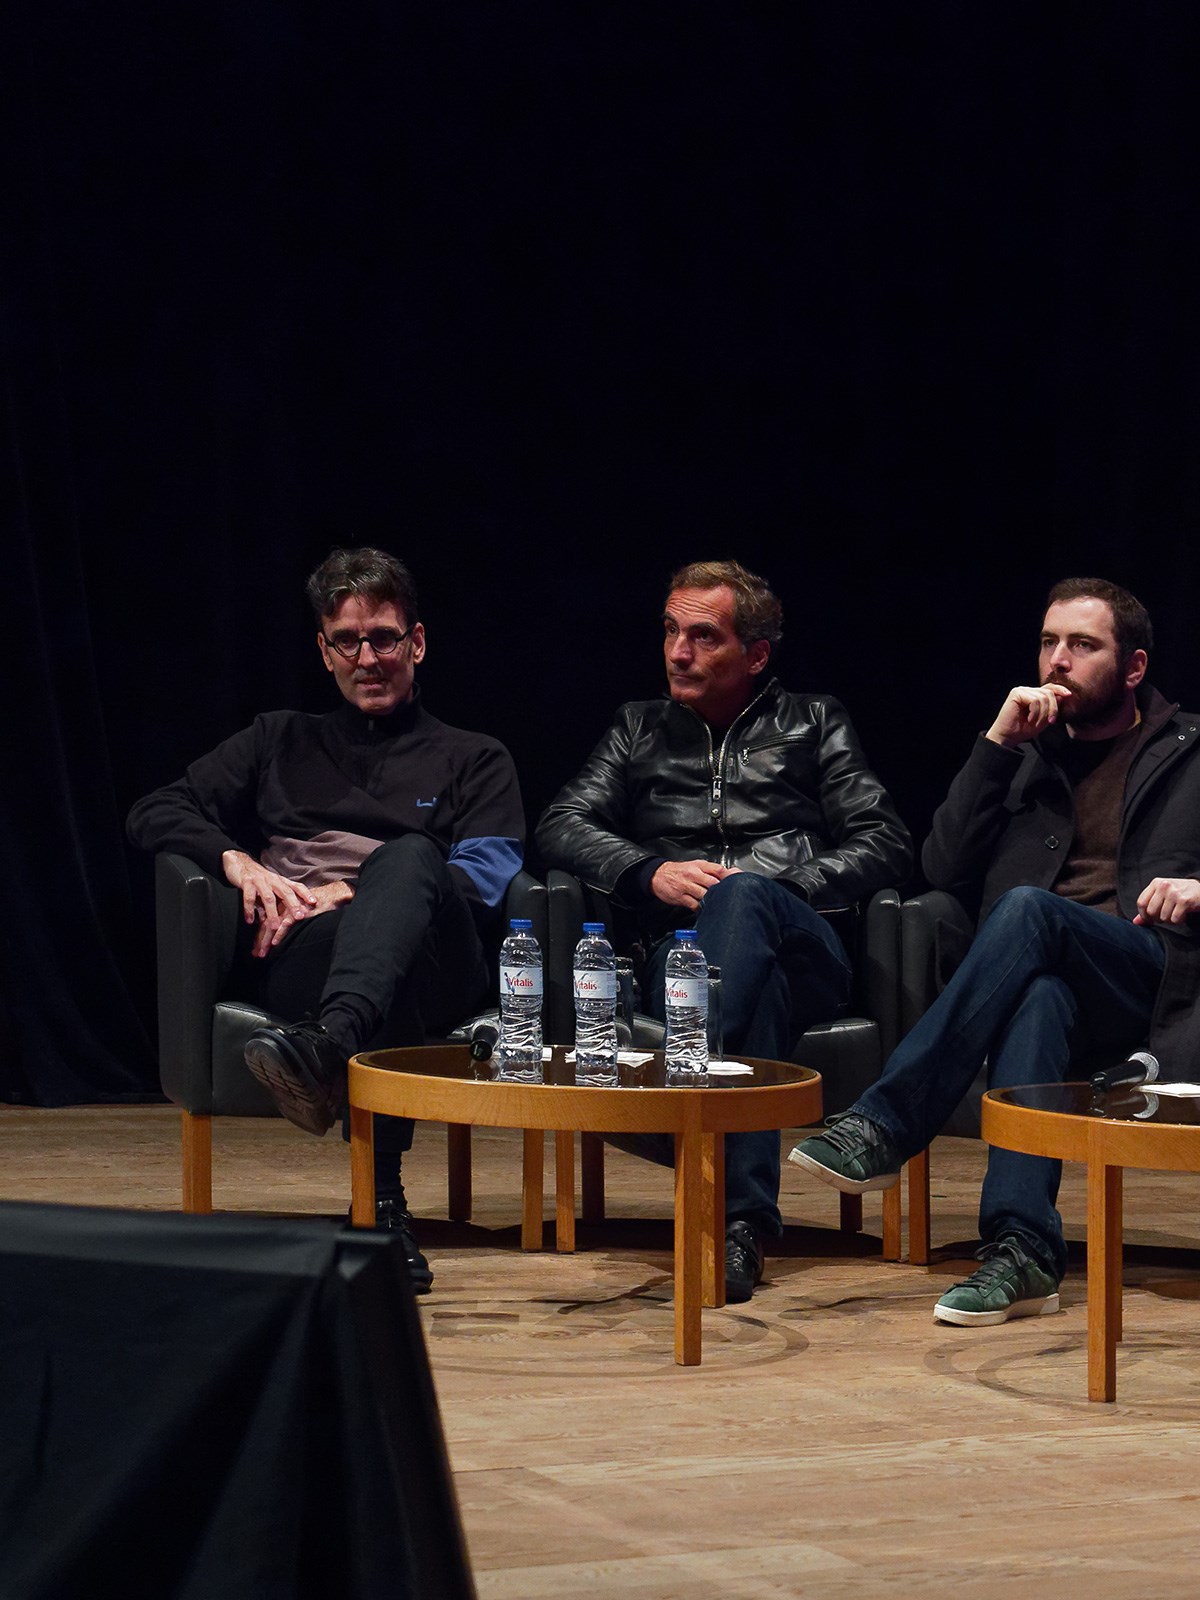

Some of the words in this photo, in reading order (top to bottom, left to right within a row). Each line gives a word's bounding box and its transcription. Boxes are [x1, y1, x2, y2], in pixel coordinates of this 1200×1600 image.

[509, 977, 534, 987] Vitalis
[574, 979, 598, 990] Vitalis
[665, 986, 688, 998] Vitalis
